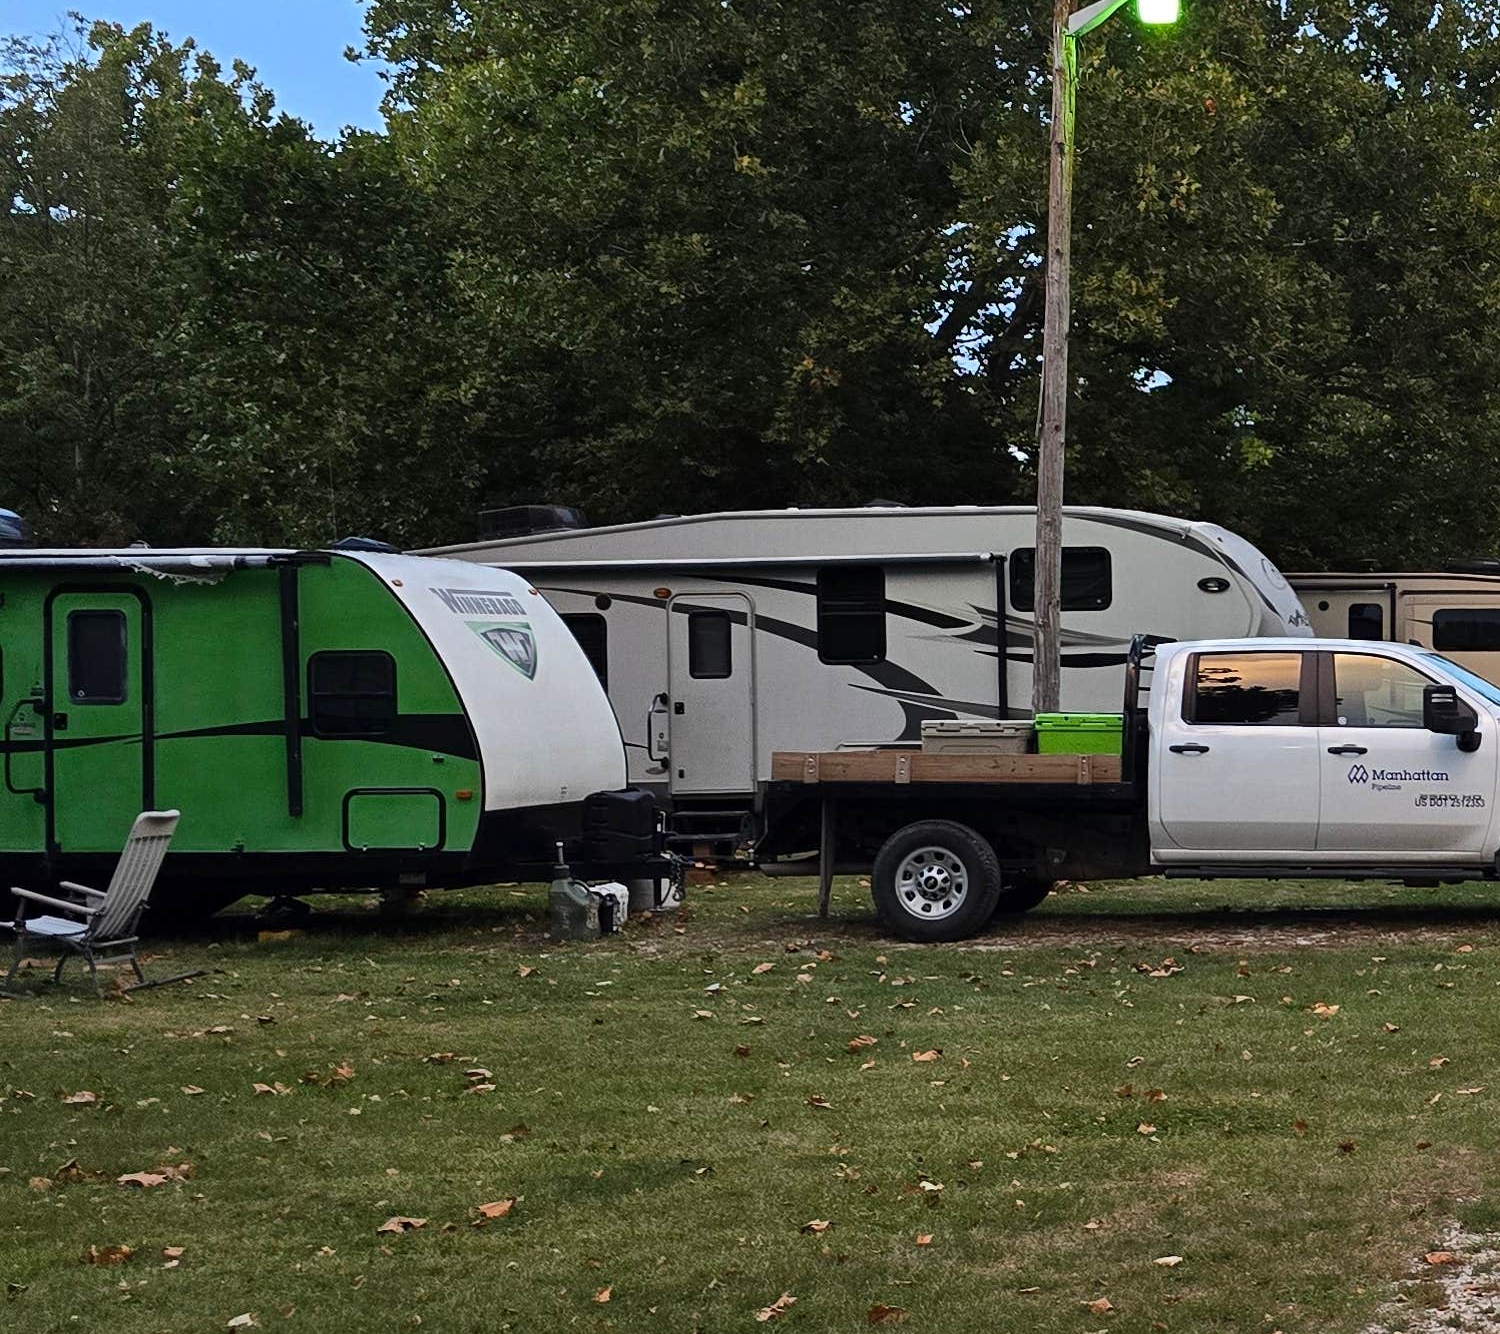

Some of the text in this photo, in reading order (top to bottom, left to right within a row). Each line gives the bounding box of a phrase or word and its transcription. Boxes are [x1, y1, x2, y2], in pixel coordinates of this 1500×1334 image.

[429, 588, 527, 615] WINNEBAGO
[1372, 770, 1449, 781] Manhattan
[1415, 797, 1428, 807] US
